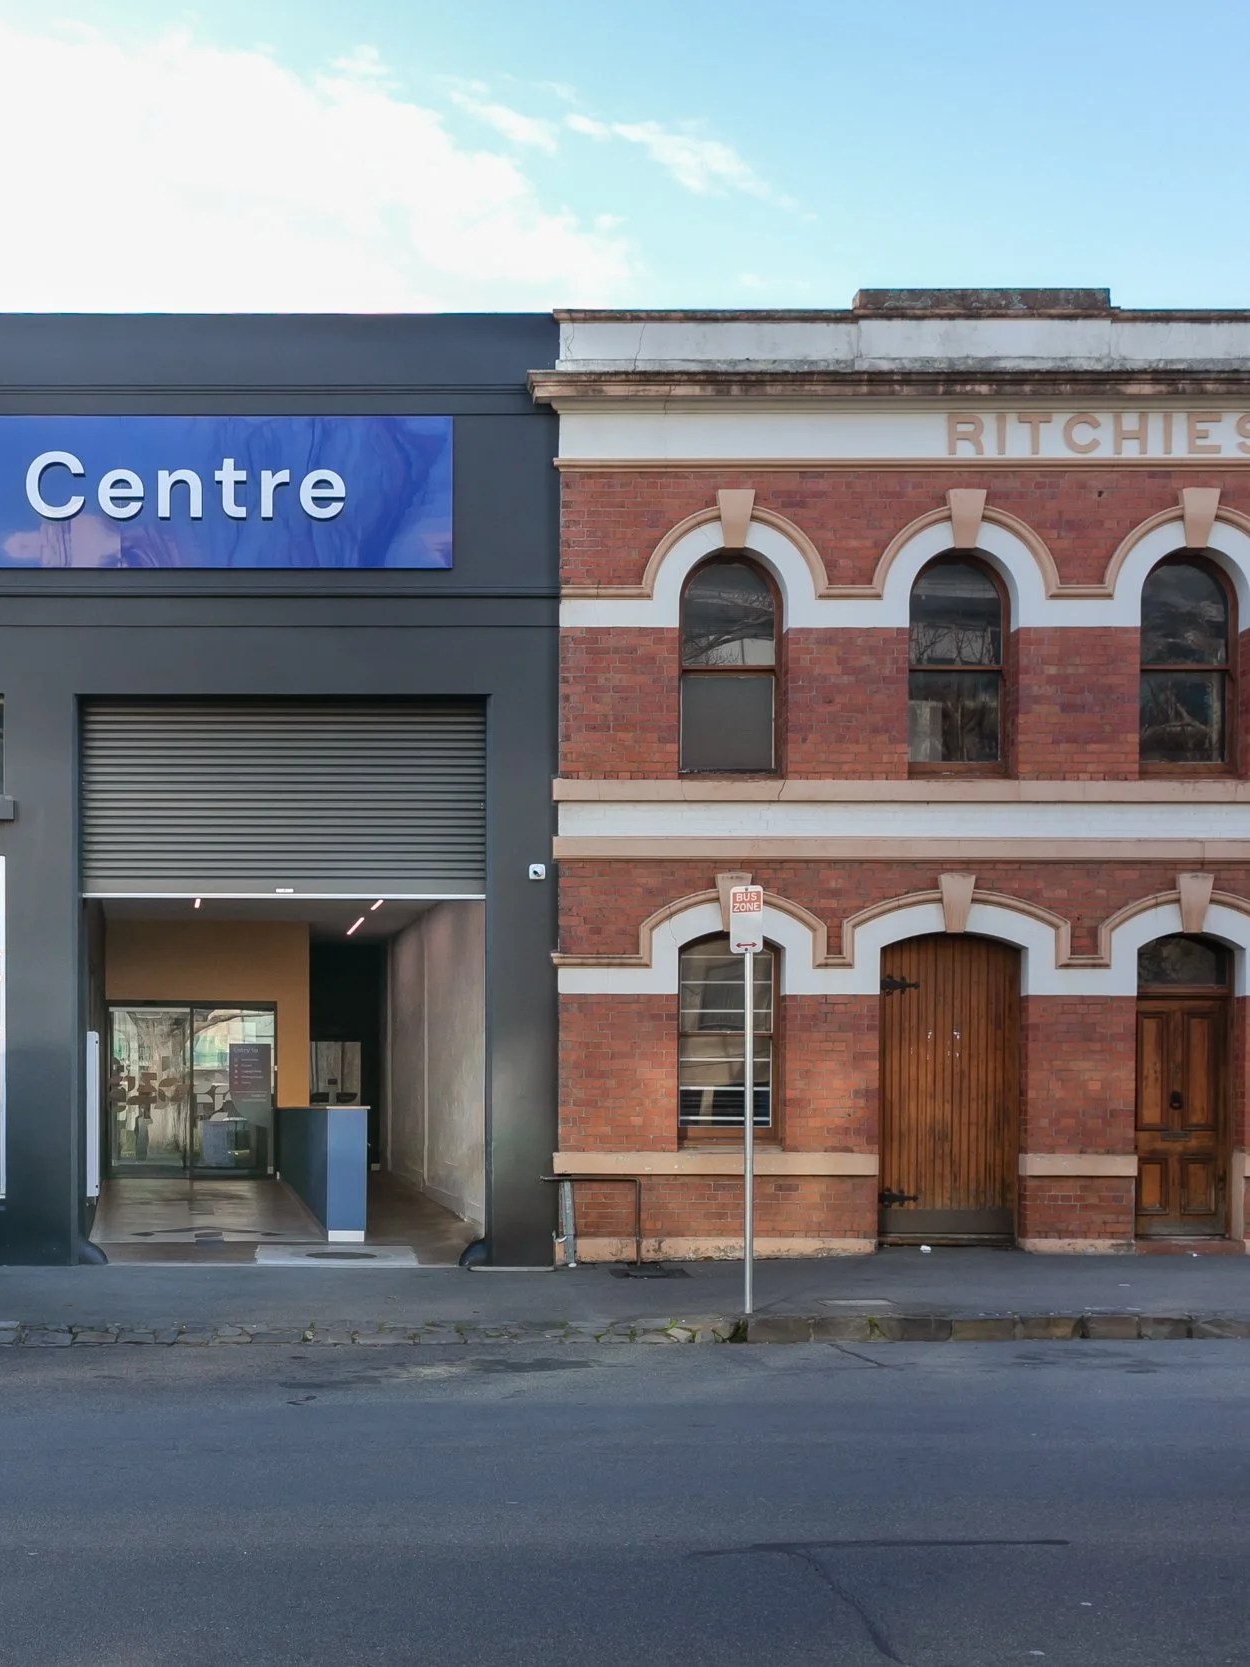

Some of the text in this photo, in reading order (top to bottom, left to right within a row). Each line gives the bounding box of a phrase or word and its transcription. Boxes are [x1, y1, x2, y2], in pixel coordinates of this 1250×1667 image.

[25, 450, 348, 521] Centre
[736, 892, 757, 901] BUS
[733, 902, 760, 912] ZONE
